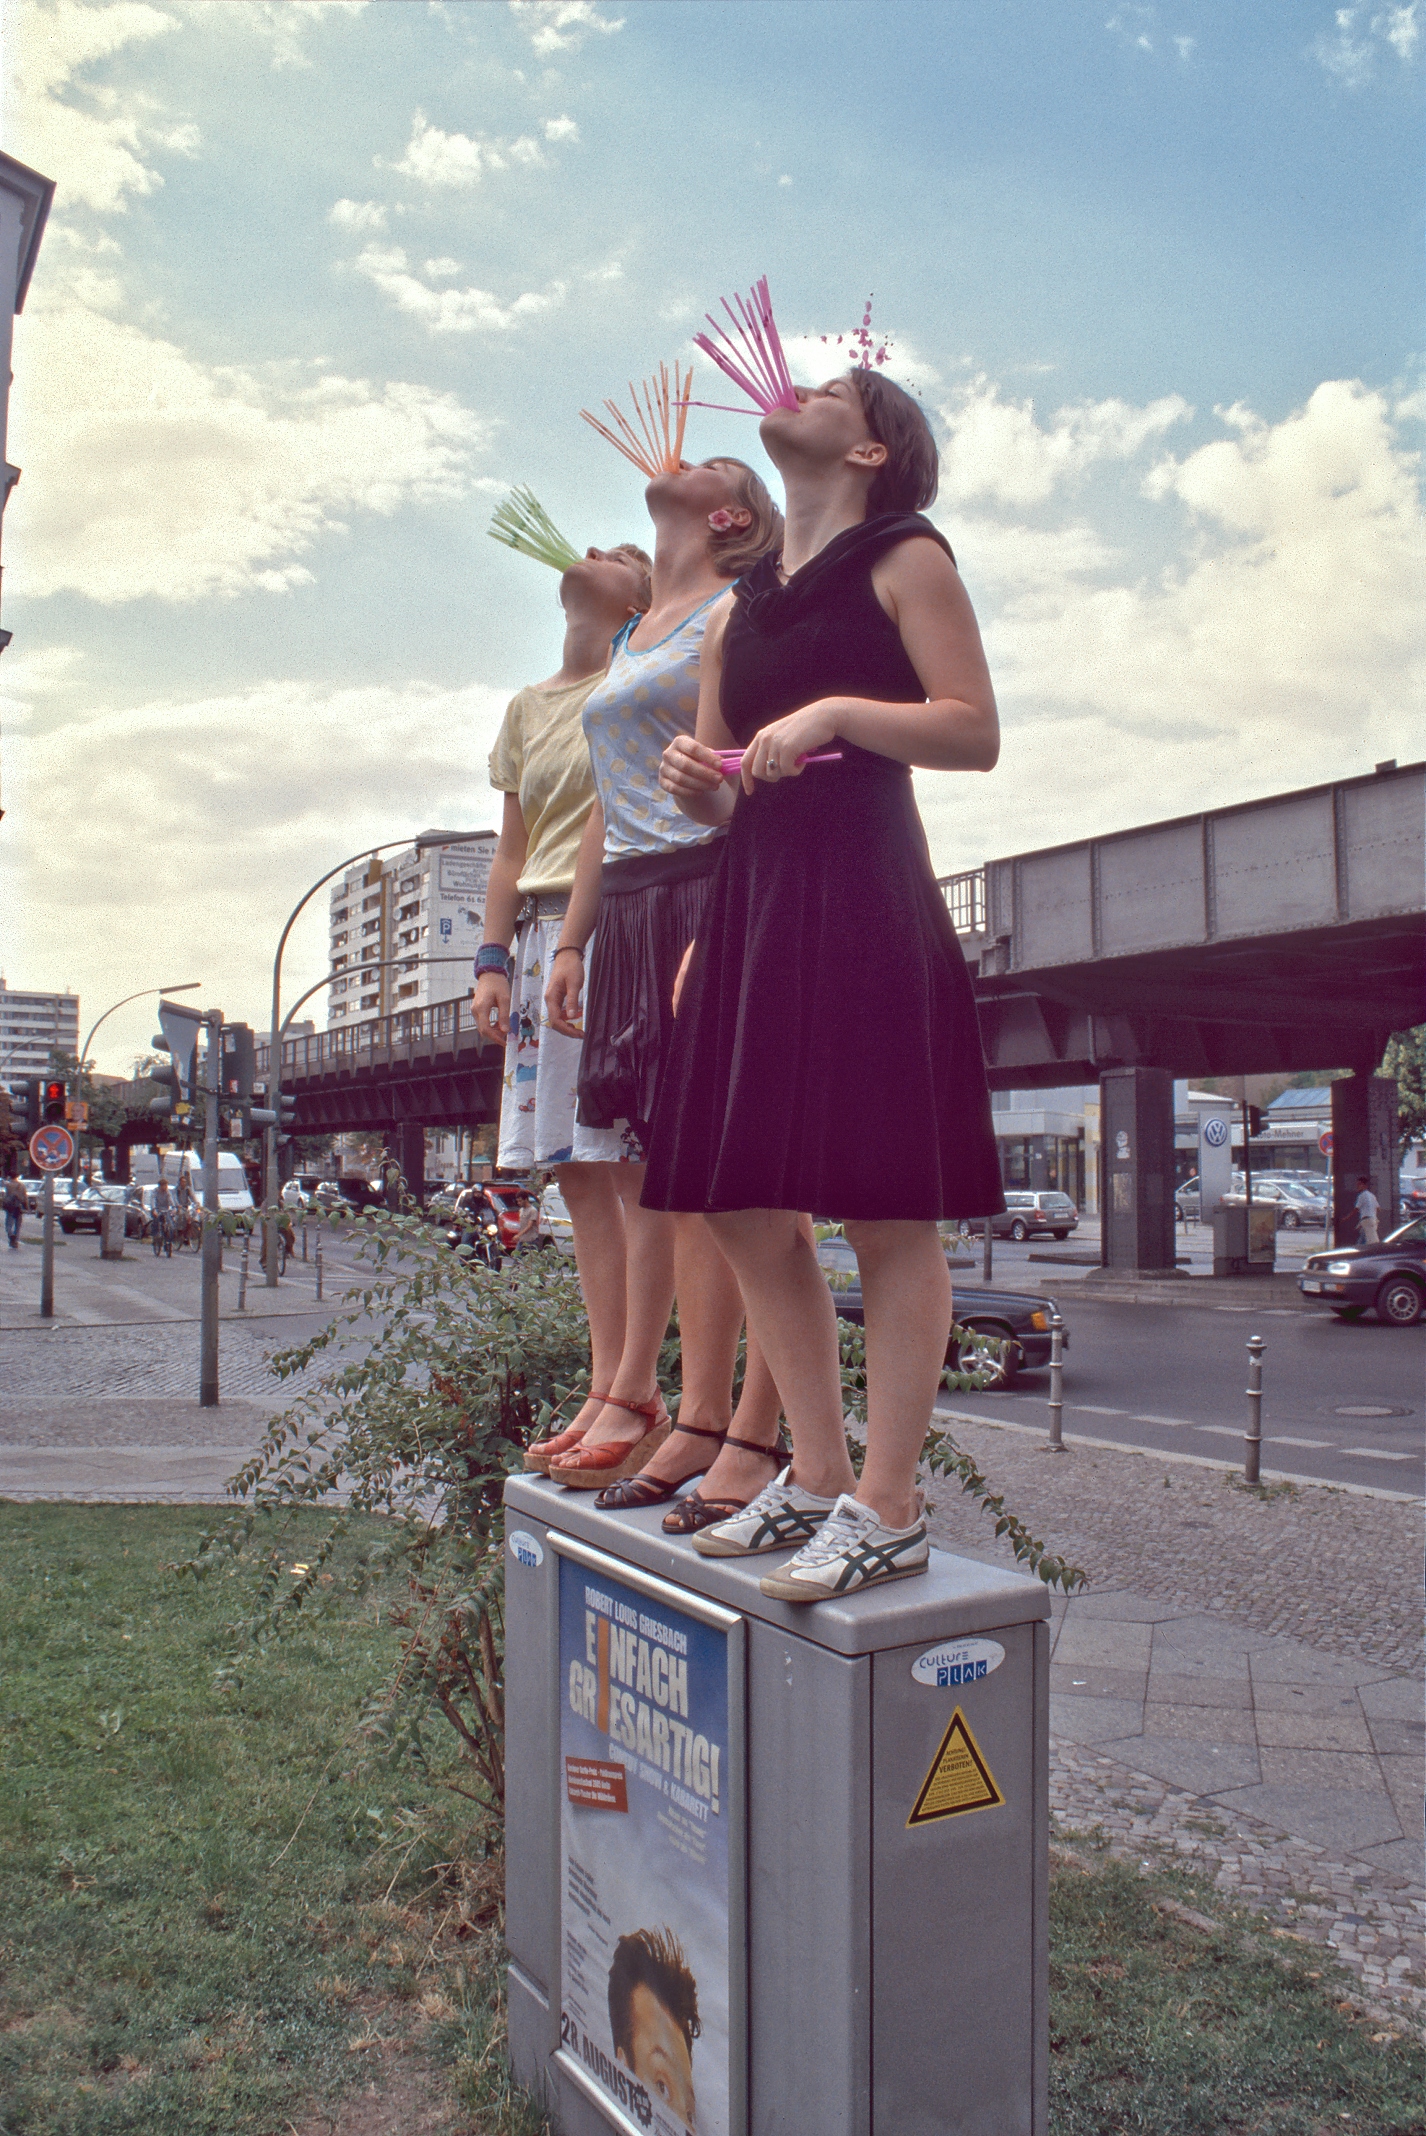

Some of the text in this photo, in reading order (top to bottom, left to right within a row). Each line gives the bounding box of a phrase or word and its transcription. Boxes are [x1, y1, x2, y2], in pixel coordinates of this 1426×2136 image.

[451, 845, 476, 853] mieten
[477, 846, 490, 854] Sie
[440, 893, 465, 902] Telefon
[1257, 1128, 1304, 1139] uto-Mehner
[585, 1585, 688, 1656] ROBERT LOUIS GRIESBACH
[585, 1609, 688, 1719] EINFACH
[939, 1760, 973, 1773] VERBOTEN!
[561, 2011, 582, 2059] 28.
[583, 2034, 635, 2114] AUGUST
